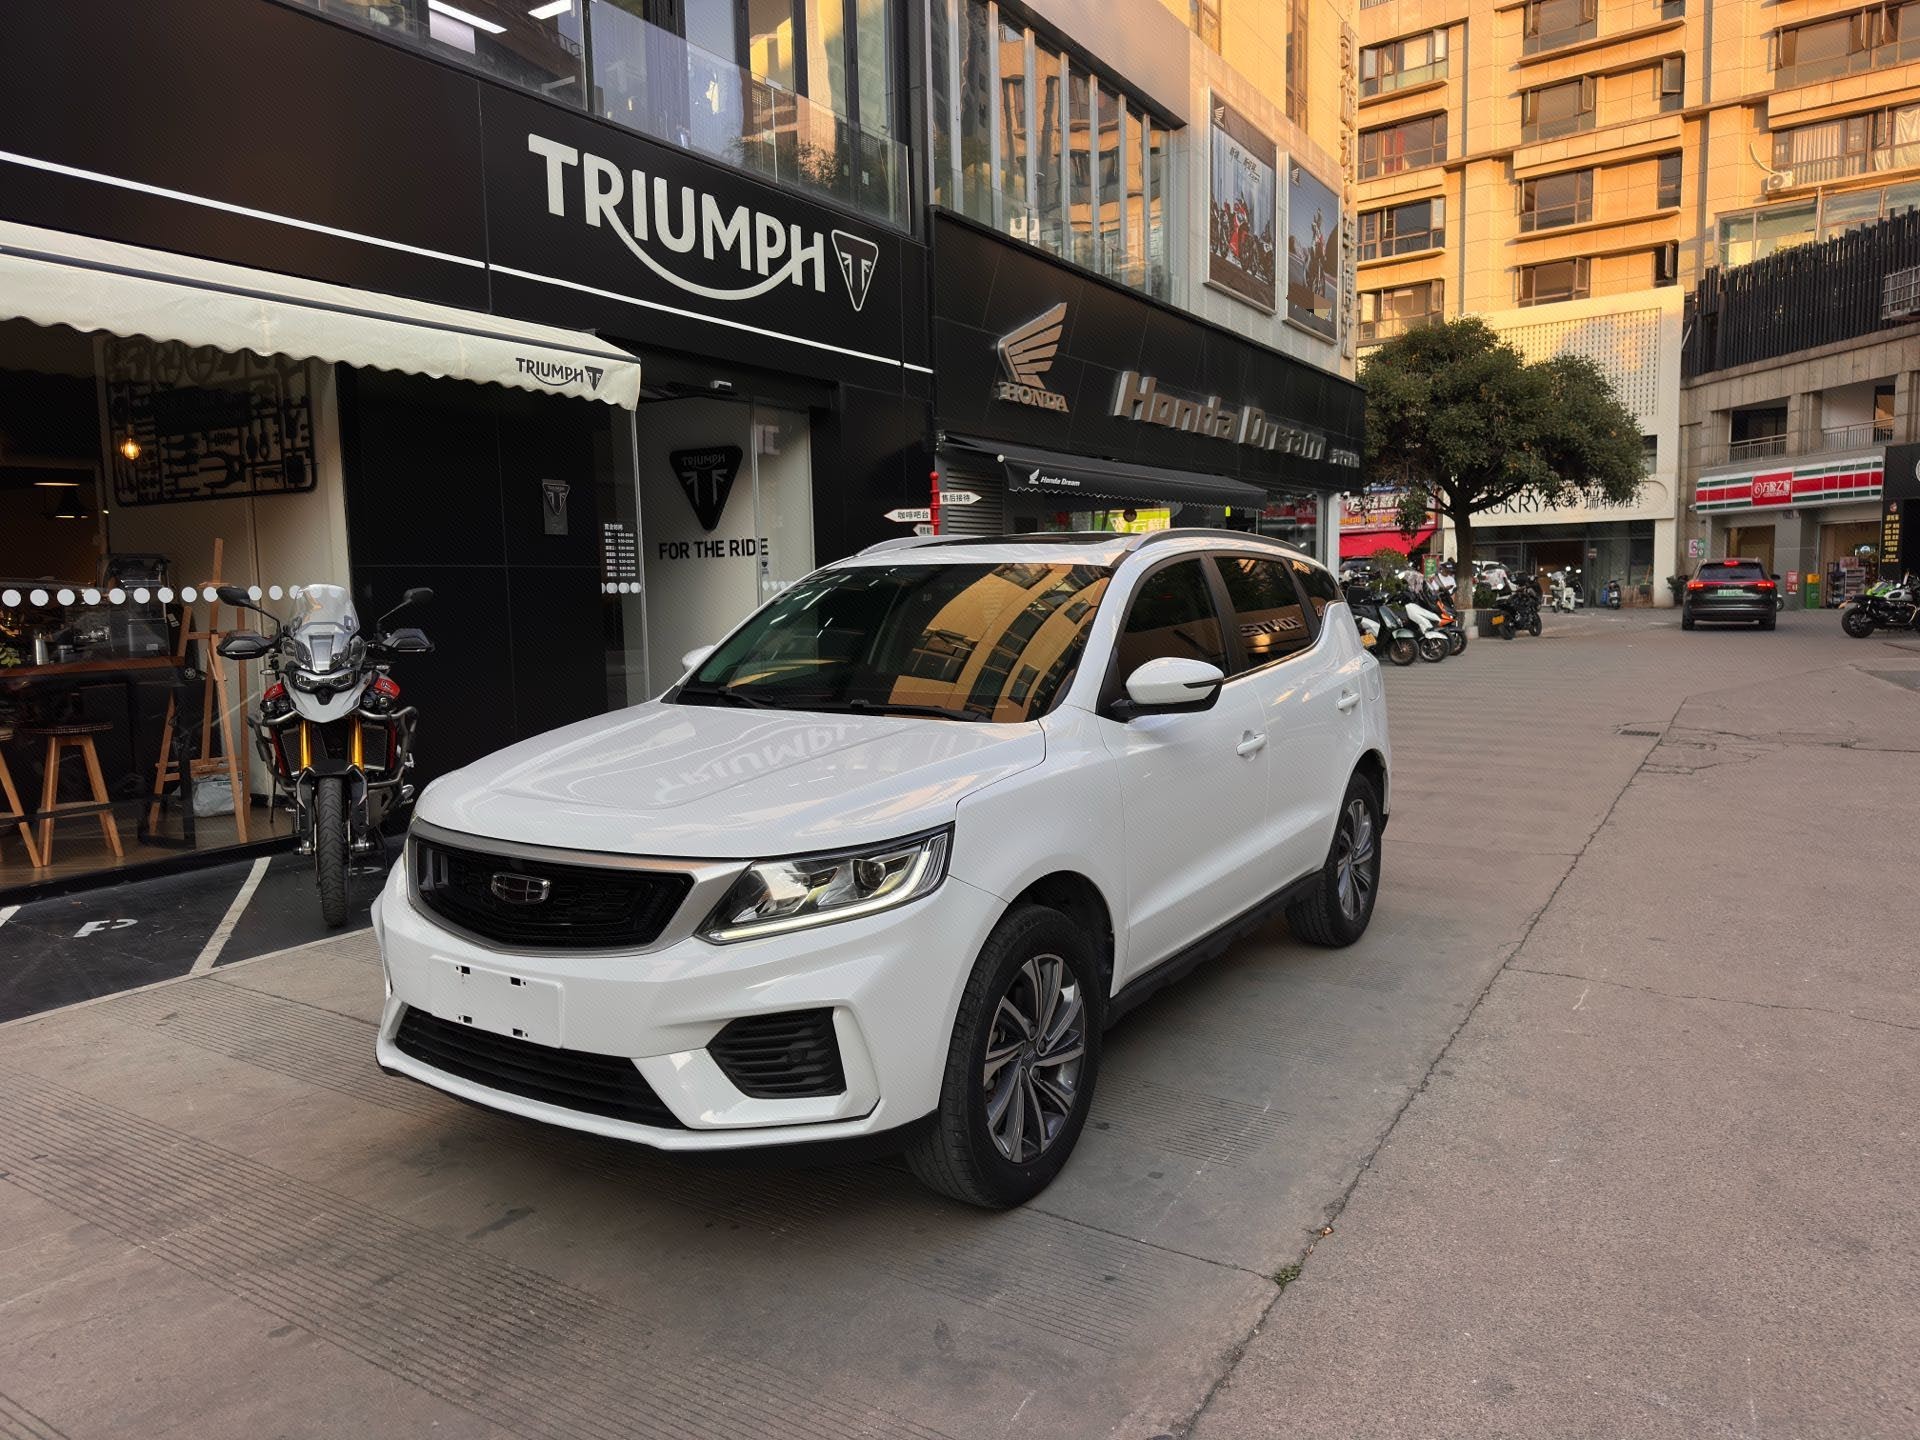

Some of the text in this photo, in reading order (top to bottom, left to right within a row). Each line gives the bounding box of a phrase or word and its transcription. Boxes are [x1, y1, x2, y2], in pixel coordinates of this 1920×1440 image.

[528, 133, 826, 301] TRIUMPH
[515, 357, 584, 386] TRIUMPH
[998, 381, 1070, 413] HONDA
[1113, 370, 1327, 460] Honda Dream
[680, 453, 726, 470] TRIUMPH
[1040, 476, 1061, 485] Honda
[1061, 478, 1081, 487] Dream
[942, 494, 970, 502] 售后接待
[897, 511, 929, 519] 咖啡吧台
[659, 538, 769, 560] FOR THE RIDE
